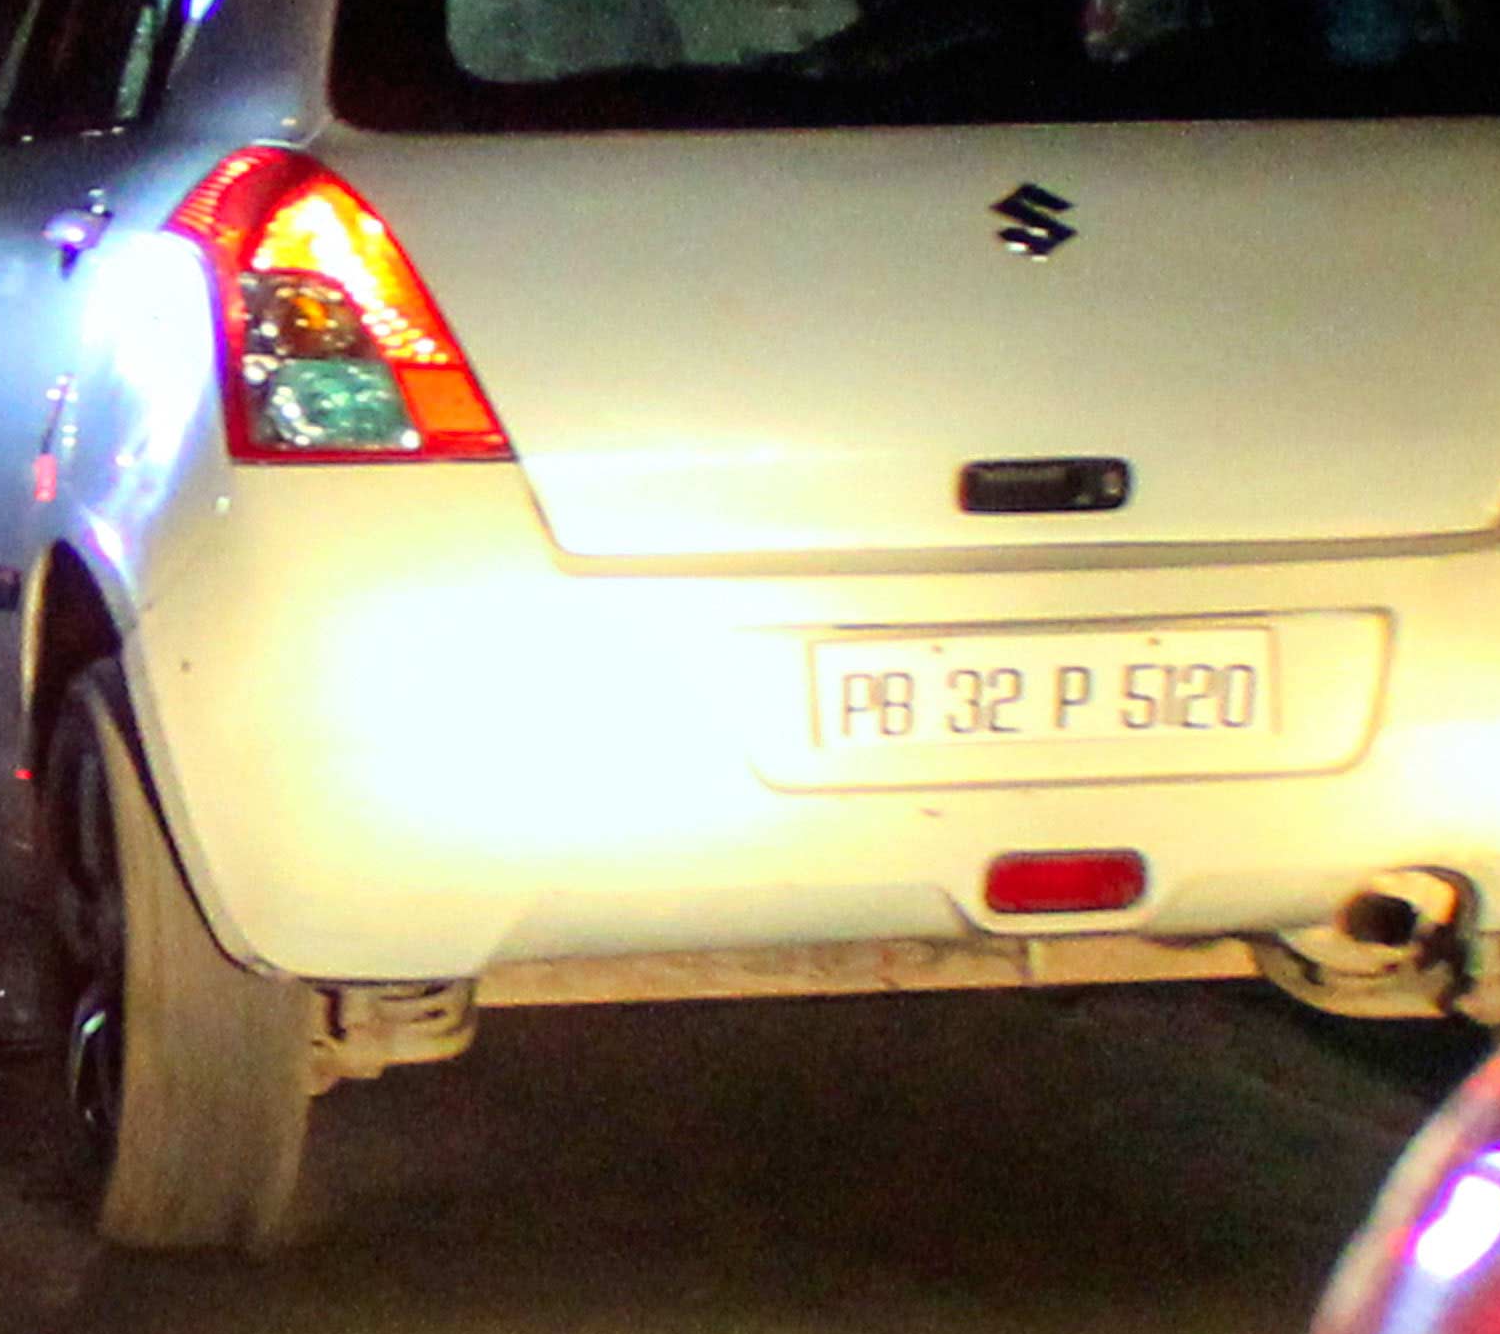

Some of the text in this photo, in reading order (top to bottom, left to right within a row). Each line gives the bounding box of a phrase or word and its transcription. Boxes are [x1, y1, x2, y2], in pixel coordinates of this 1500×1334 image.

[842, 662, 1257, 737] PB 32 P 5120
